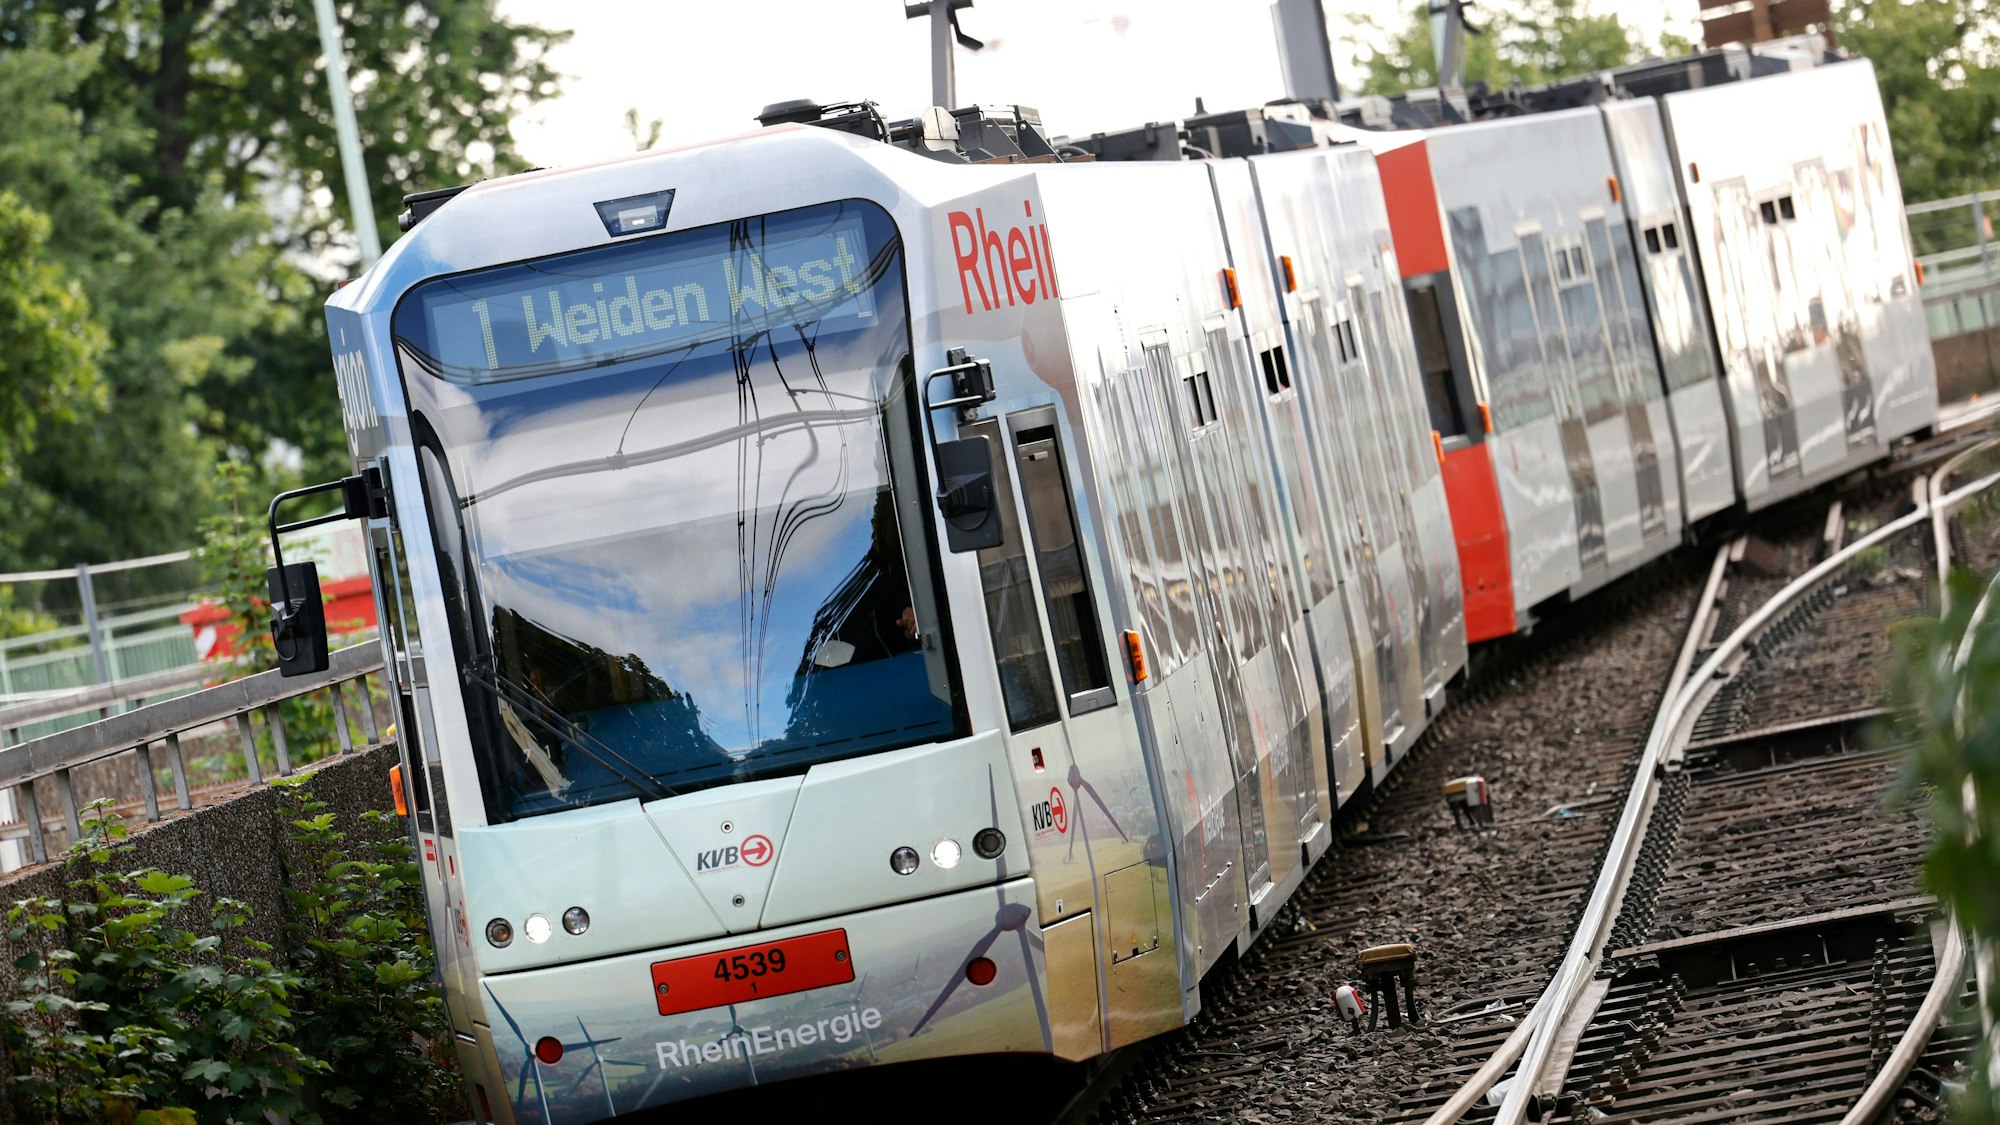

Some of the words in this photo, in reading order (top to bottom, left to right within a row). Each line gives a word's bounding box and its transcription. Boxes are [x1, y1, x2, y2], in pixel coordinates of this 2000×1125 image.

[471, 298, 499, 371] 1
[521, 275, 710, 354] Weiden
[721, 236, 863, 314] West
[1031, 800, 1053, 831] KVB
[697, 846, 739, 871] KVB
[714, 948, 786, 982] 4539
[750, 982, 758, 994] 1
[655, 1005, 883, 1070] RheinEnergie
